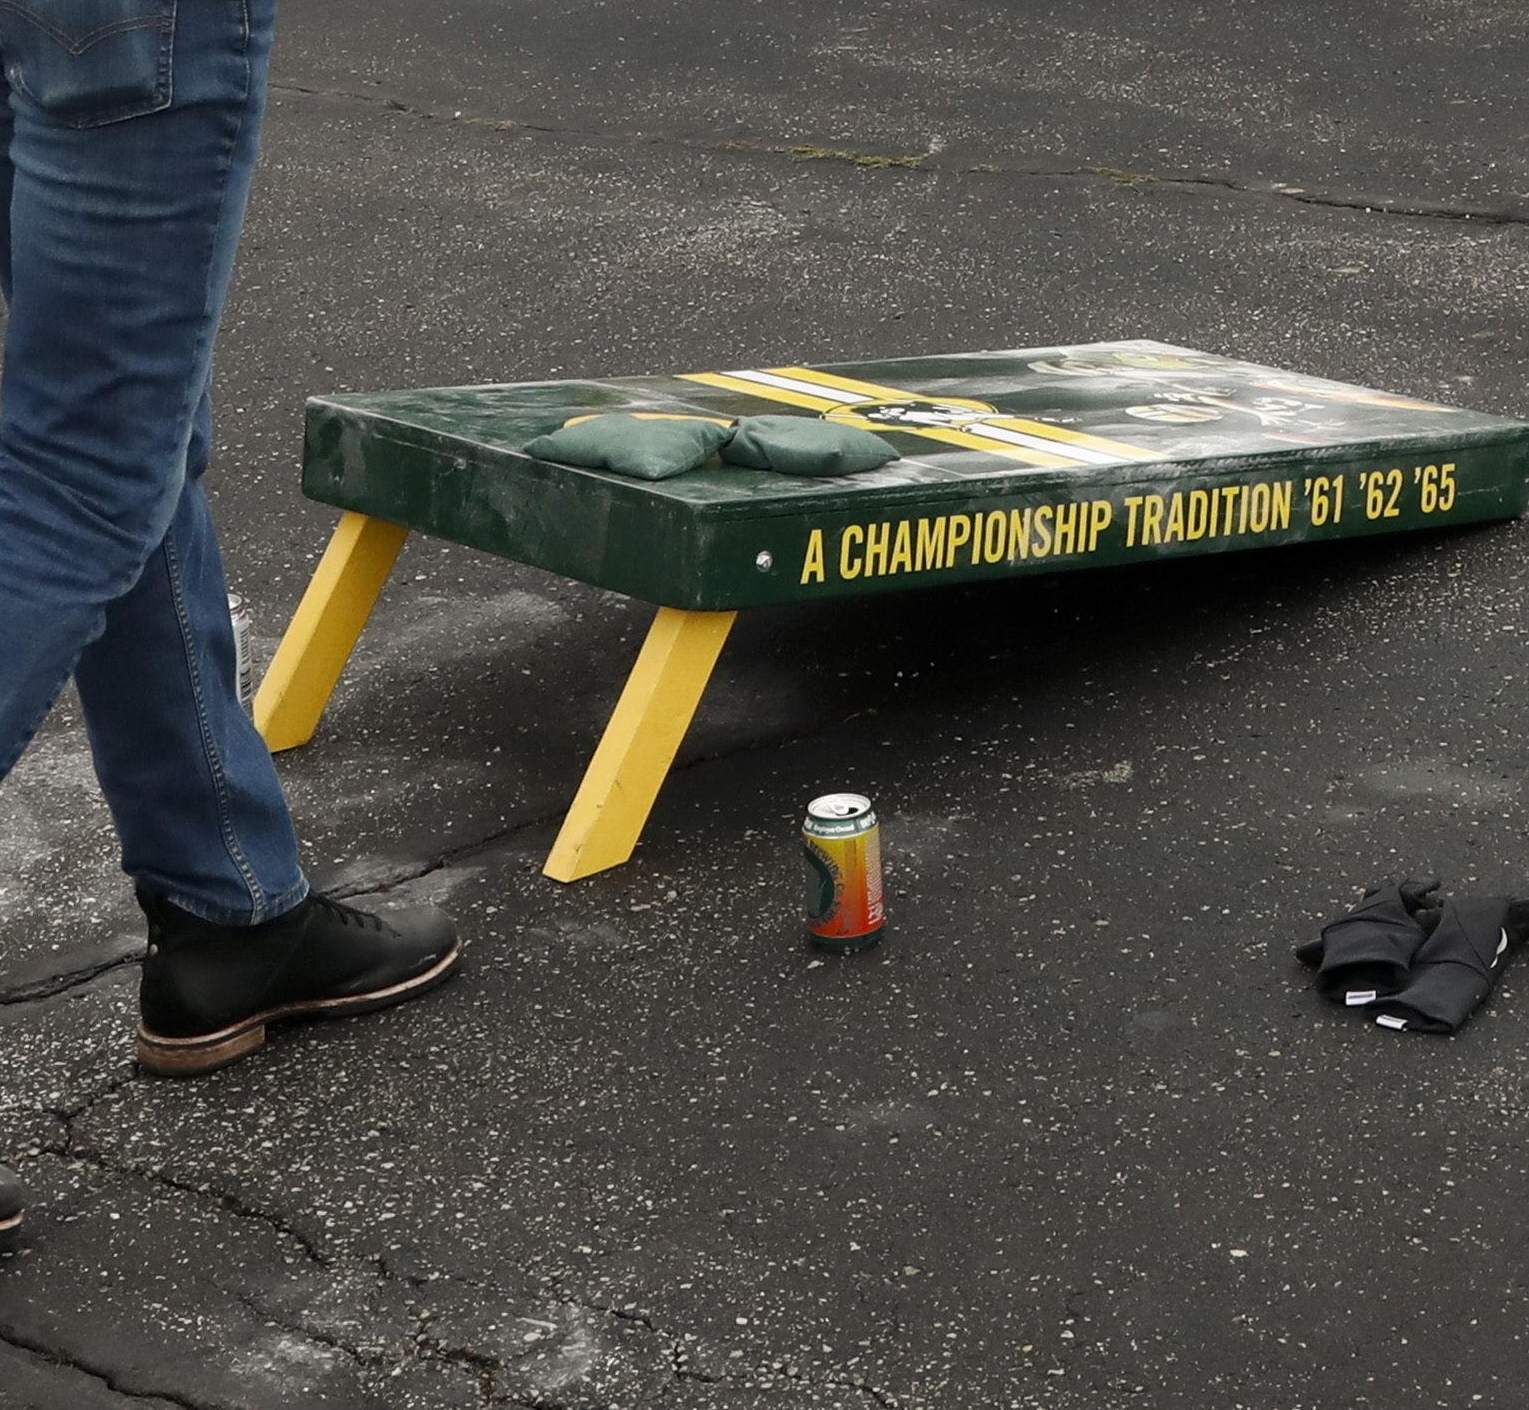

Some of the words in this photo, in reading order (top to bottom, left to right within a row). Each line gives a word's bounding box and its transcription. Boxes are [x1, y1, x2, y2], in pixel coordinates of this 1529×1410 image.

[800, 528, 825, 585] A
[839, 499, 1112, 581] CHAMPIONSHIP
[1124, 480, 1292, 548] TRADITION
[1304, 474, 1344, 527] '61
[1359, 468, 1404, 520] '62
[1414, 462, 1456, 514] '65
